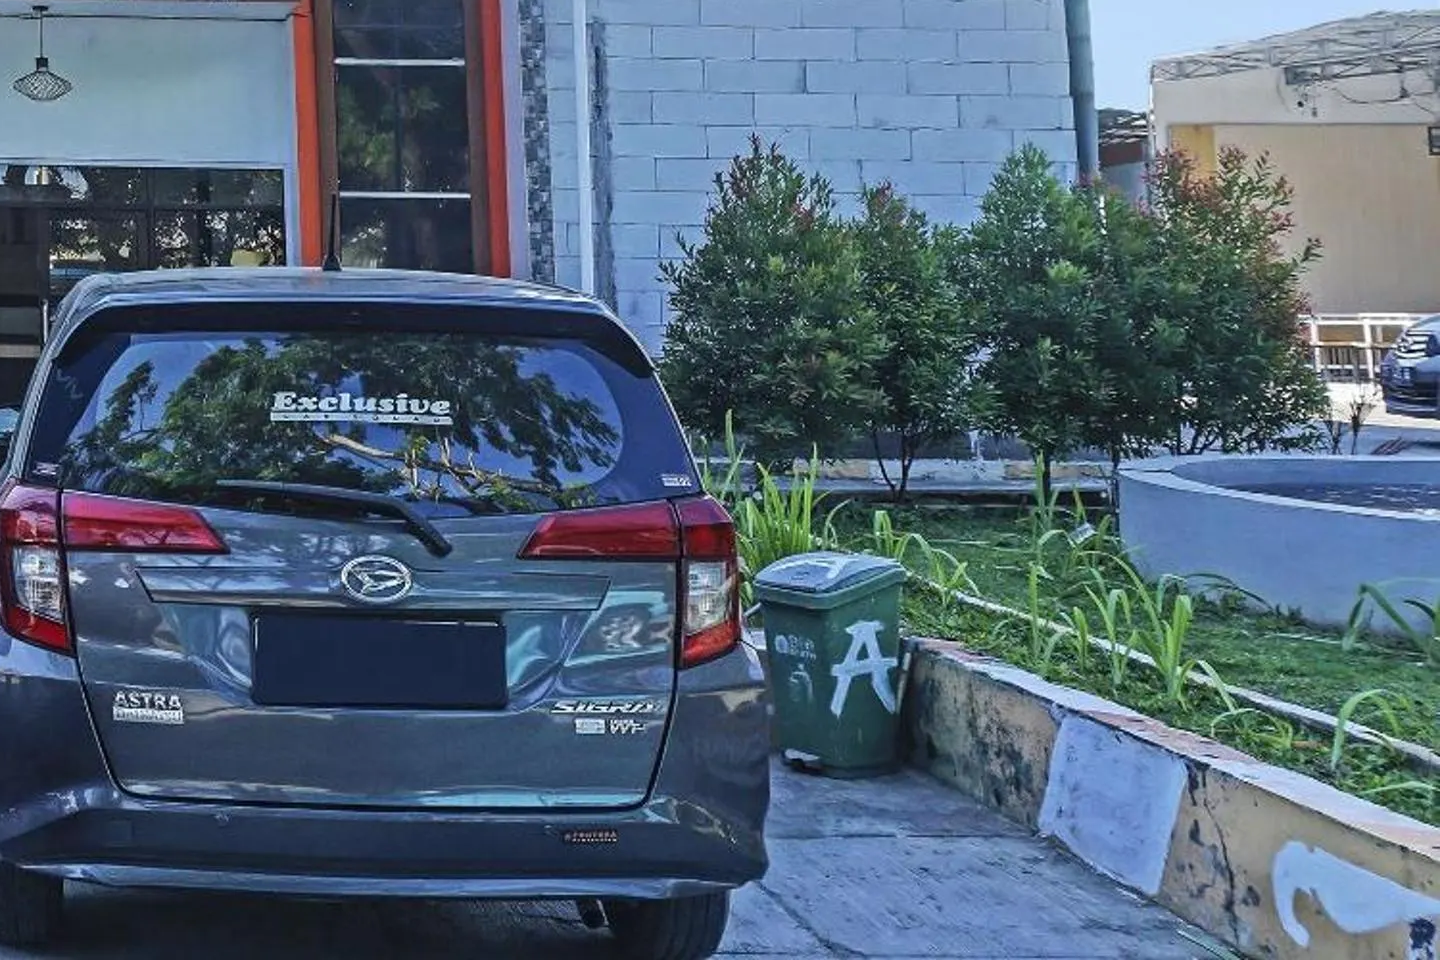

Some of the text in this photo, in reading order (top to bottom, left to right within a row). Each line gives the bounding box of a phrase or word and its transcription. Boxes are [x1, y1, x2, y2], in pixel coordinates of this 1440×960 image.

[272, 392, 450, 415] Exclusive
[830, 620, 899, 719] A
[114, 691, 181, 709] ASTRA
